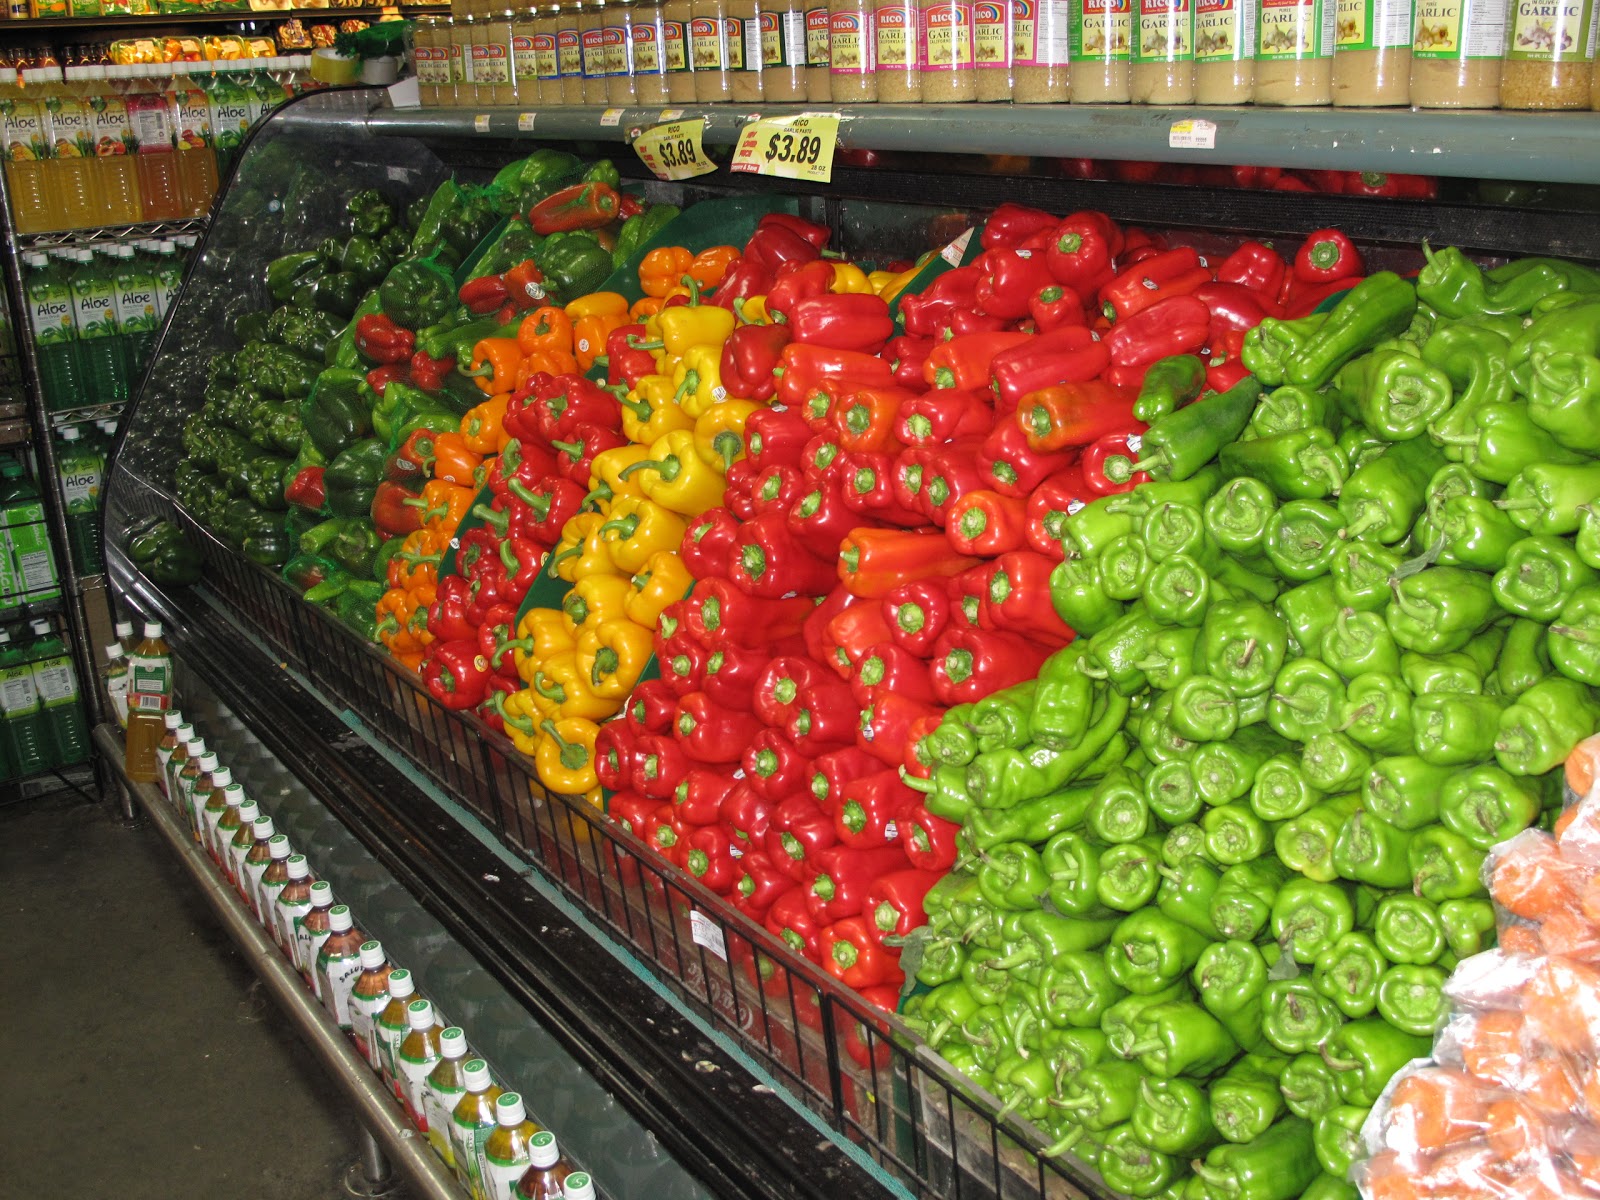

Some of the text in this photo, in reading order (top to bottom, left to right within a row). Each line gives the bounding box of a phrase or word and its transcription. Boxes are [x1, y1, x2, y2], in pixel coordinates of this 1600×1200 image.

[1262, 12, 1311, 24] GARLC
[1142, 19, 1188, 29] GARIC
[180, 107, 206, 118] Aloe
[218, 107, 245, 118] Aloe
[5, 117, 36, 128] Aloe
[52, 114, 81, 125] Aloe
[96, 113, 125, 125] Aloe
[668, 126, 680, 134] RICO
[765, 133, 821, 164] $3.89
[659, 139, 696, 170] $3.89
[81, 297, 110, 310] Aloe
[123, 293, 151, 304] Aloe
[38, 303, 67, 316] Aloe
[66, 475, 94, 487] Aloe
[43, 660, 61, 668] Aloe
